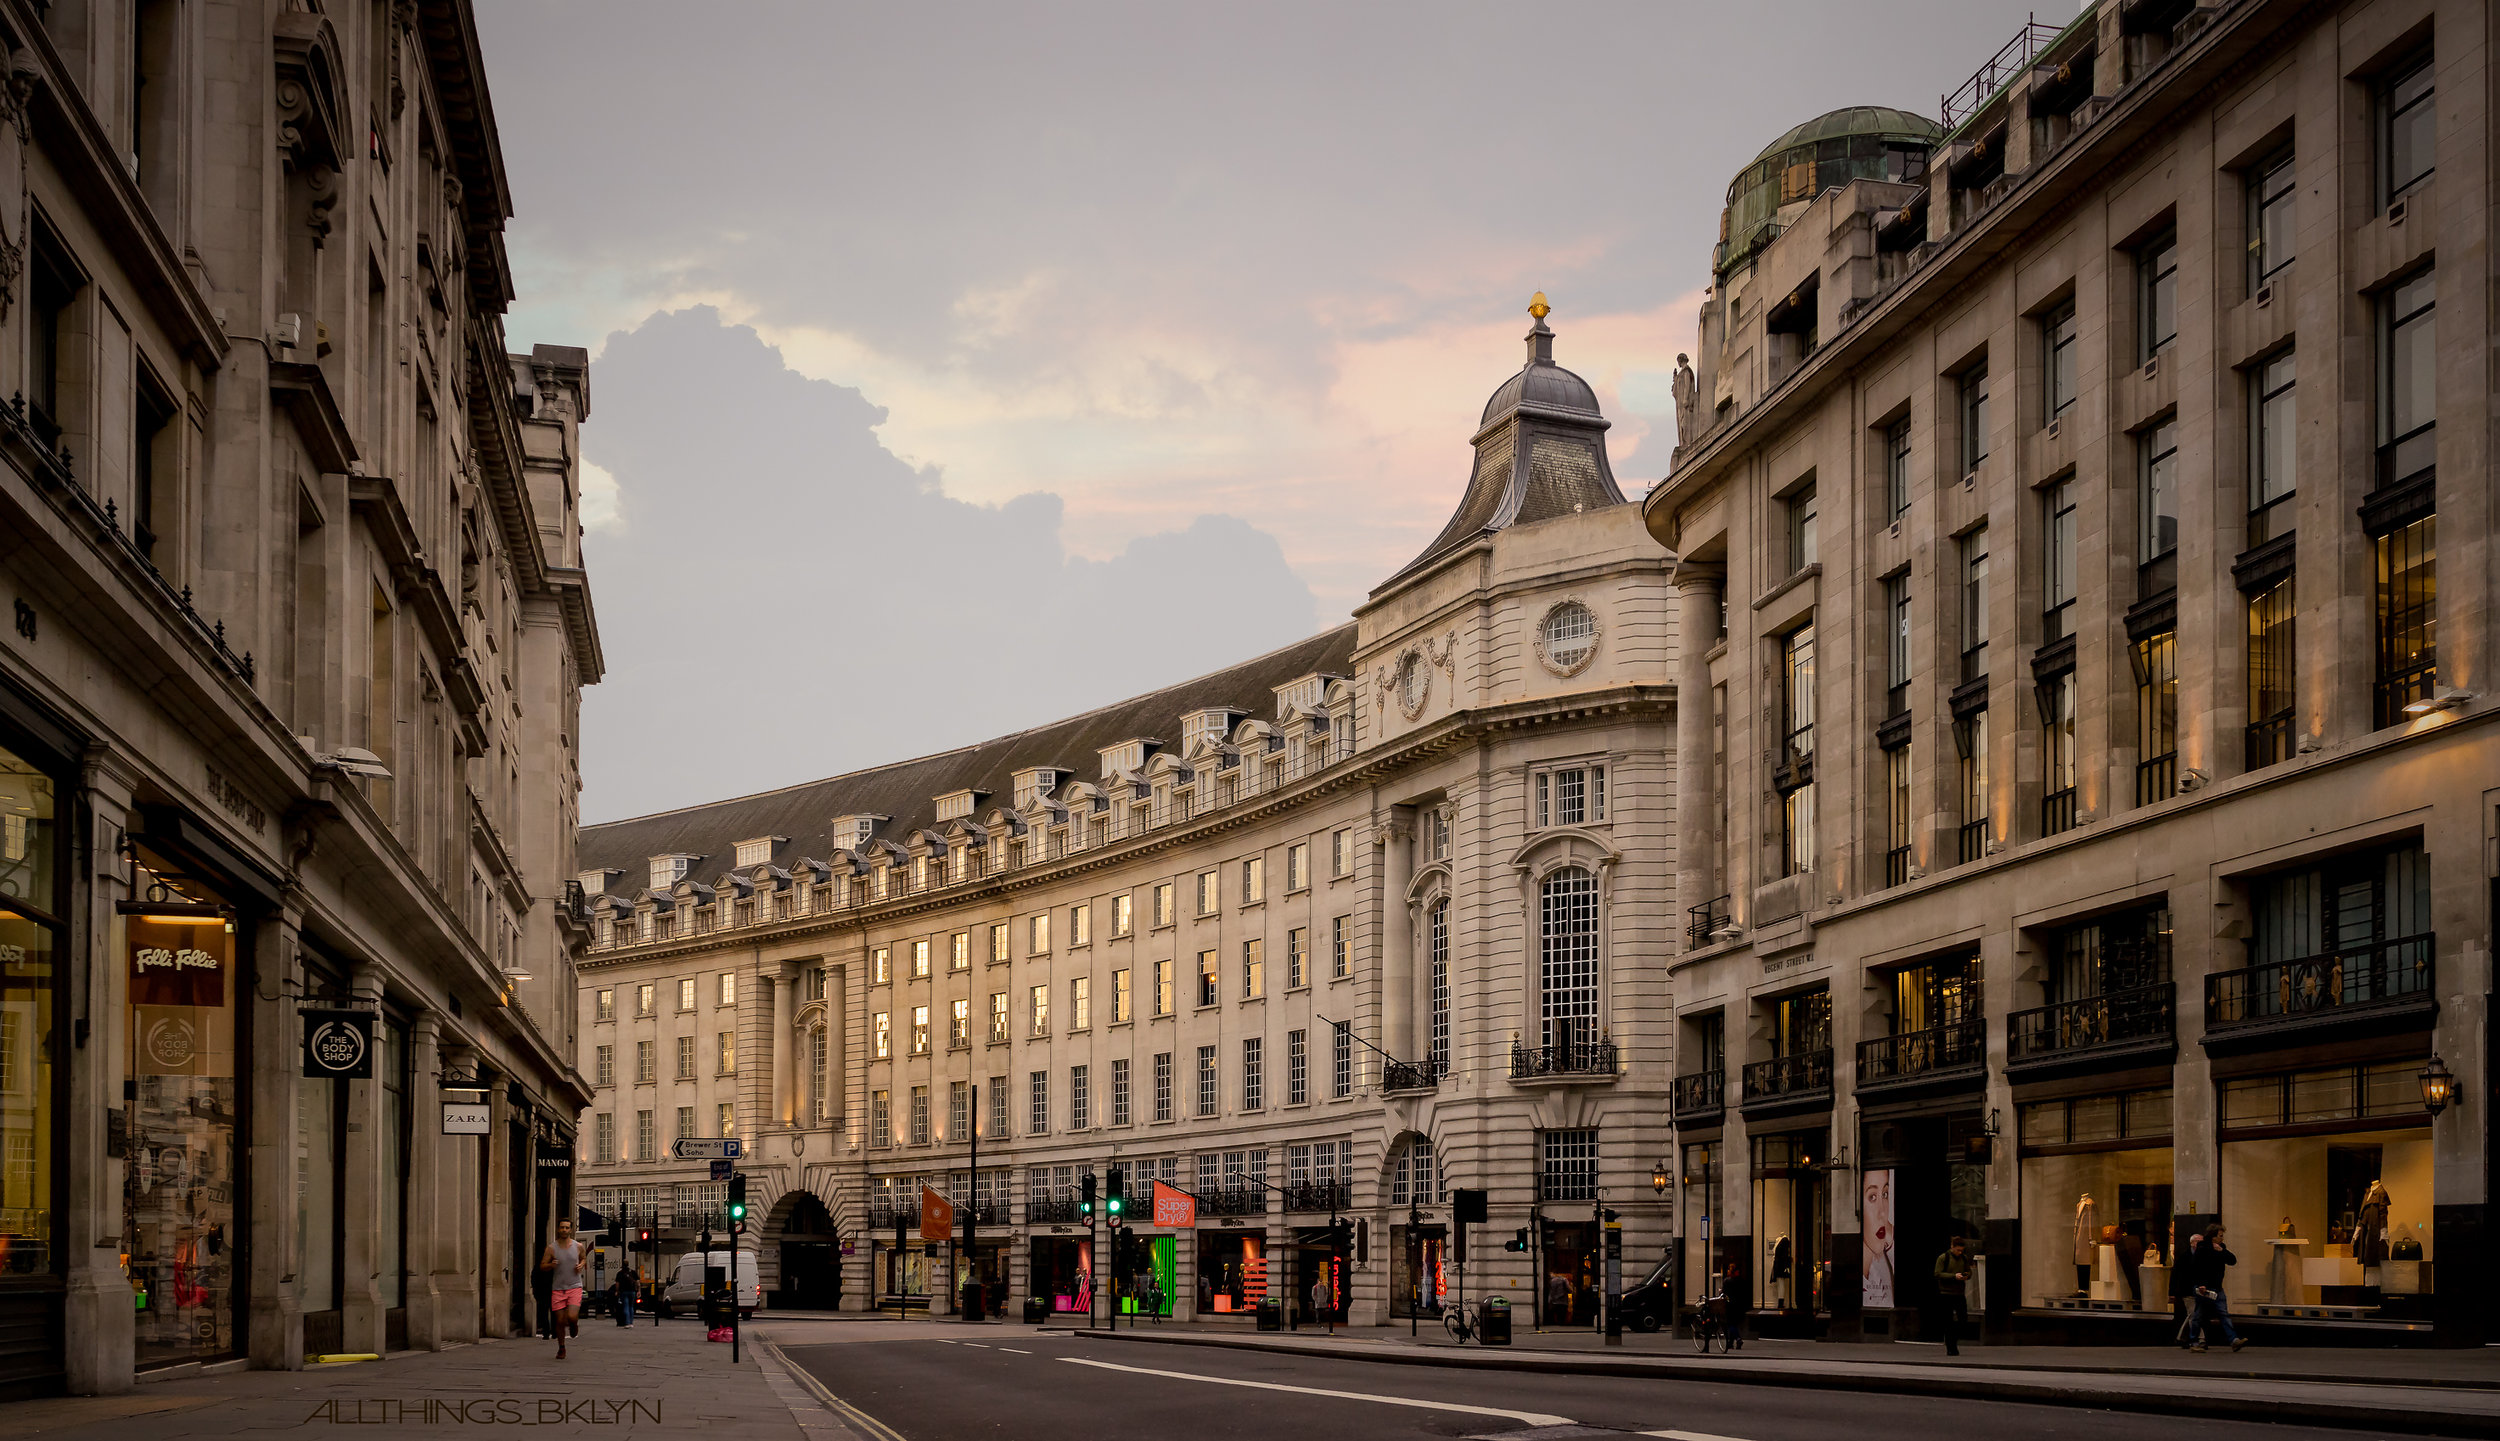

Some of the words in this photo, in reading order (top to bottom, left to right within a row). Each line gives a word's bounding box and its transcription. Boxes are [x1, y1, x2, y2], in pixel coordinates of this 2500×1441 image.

[136, 948, 174, 973] Folli
[175, 948, 218, 971] Follie
[1764, 961, 1783, 974] REGENT
[1786, 955, 1805, 968] STREET
[328, 1035, 348, 1044] THE
[322, 1043, 355, 1053] BODY
[323, 1052, 353, 1061] SHOP
[446, 1115, 487, 1123] ZARA
[538, 1159, 570, 1168] MANGO
[1158, 1198, 1191, 1213] Super
